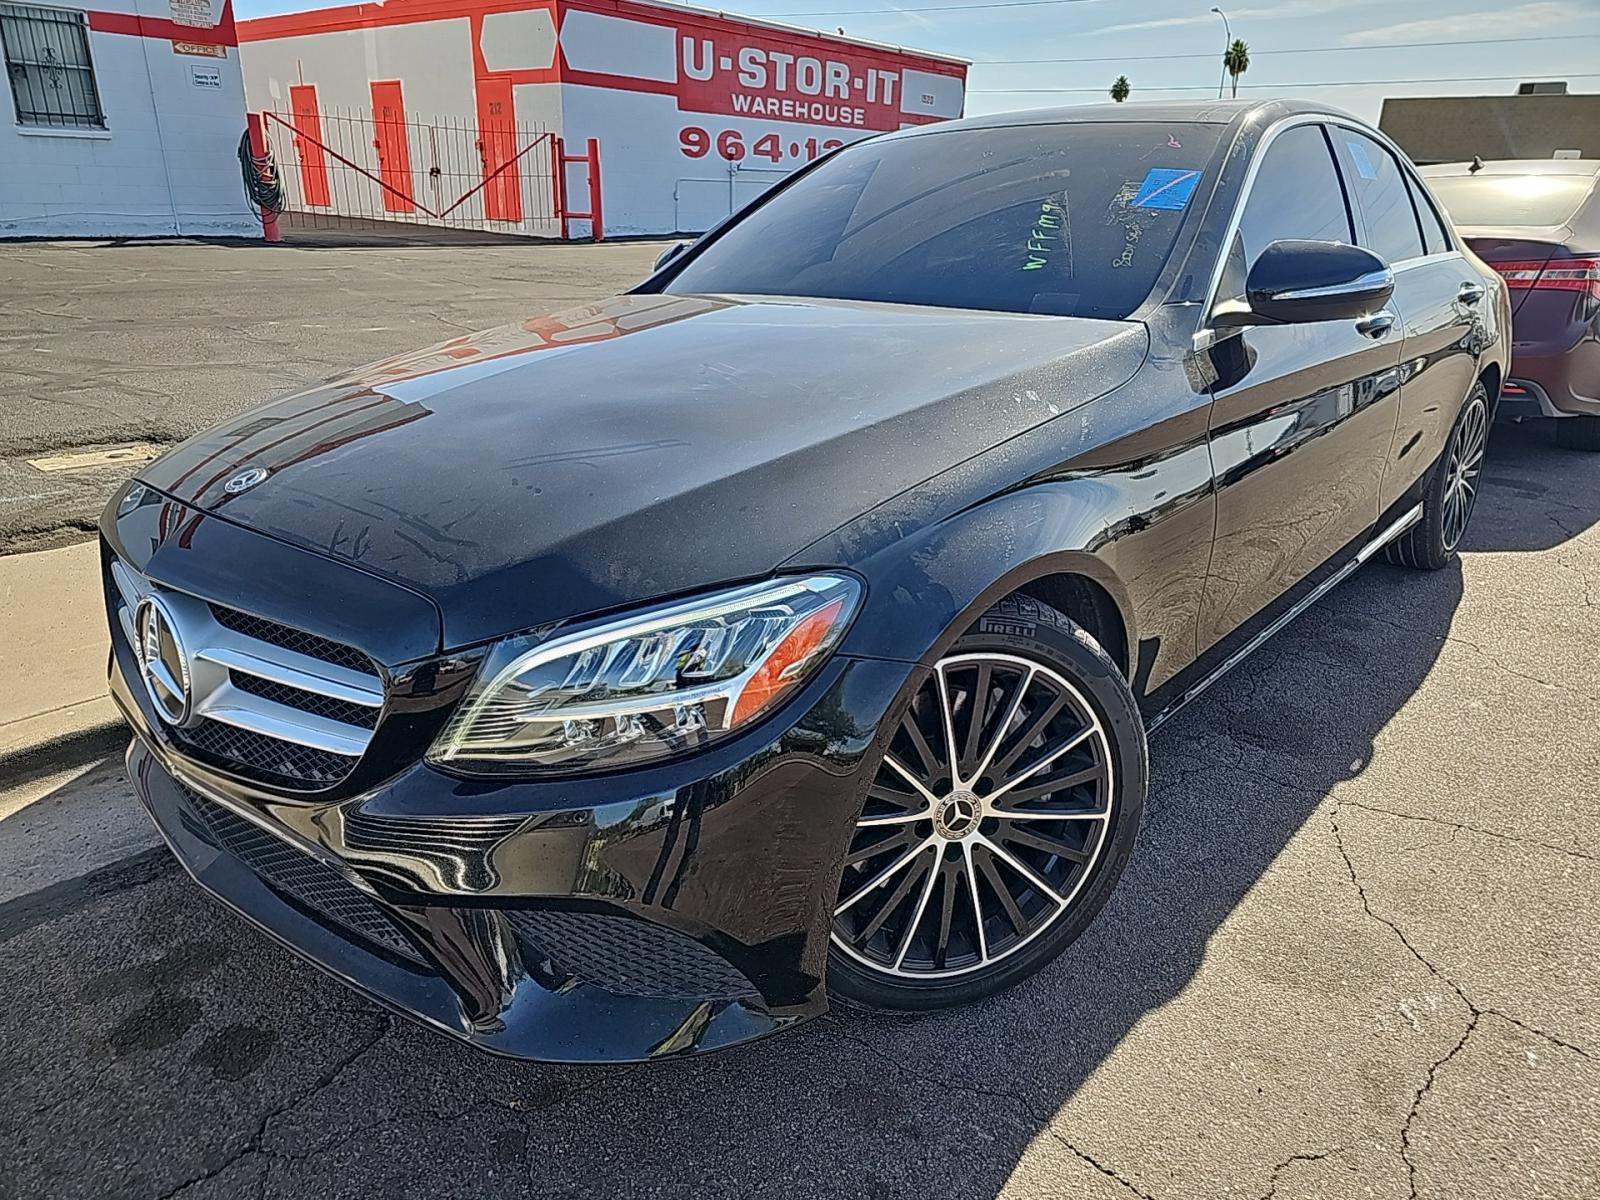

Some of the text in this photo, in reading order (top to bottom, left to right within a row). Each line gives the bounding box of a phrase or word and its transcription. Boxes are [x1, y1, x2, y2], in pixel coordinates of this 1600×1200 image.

[183, 44, 218, 55] OFFICE
[731, 93, 865, 126] WAREHOUSE
[979, 616, 1038, 638] PIRELLI
